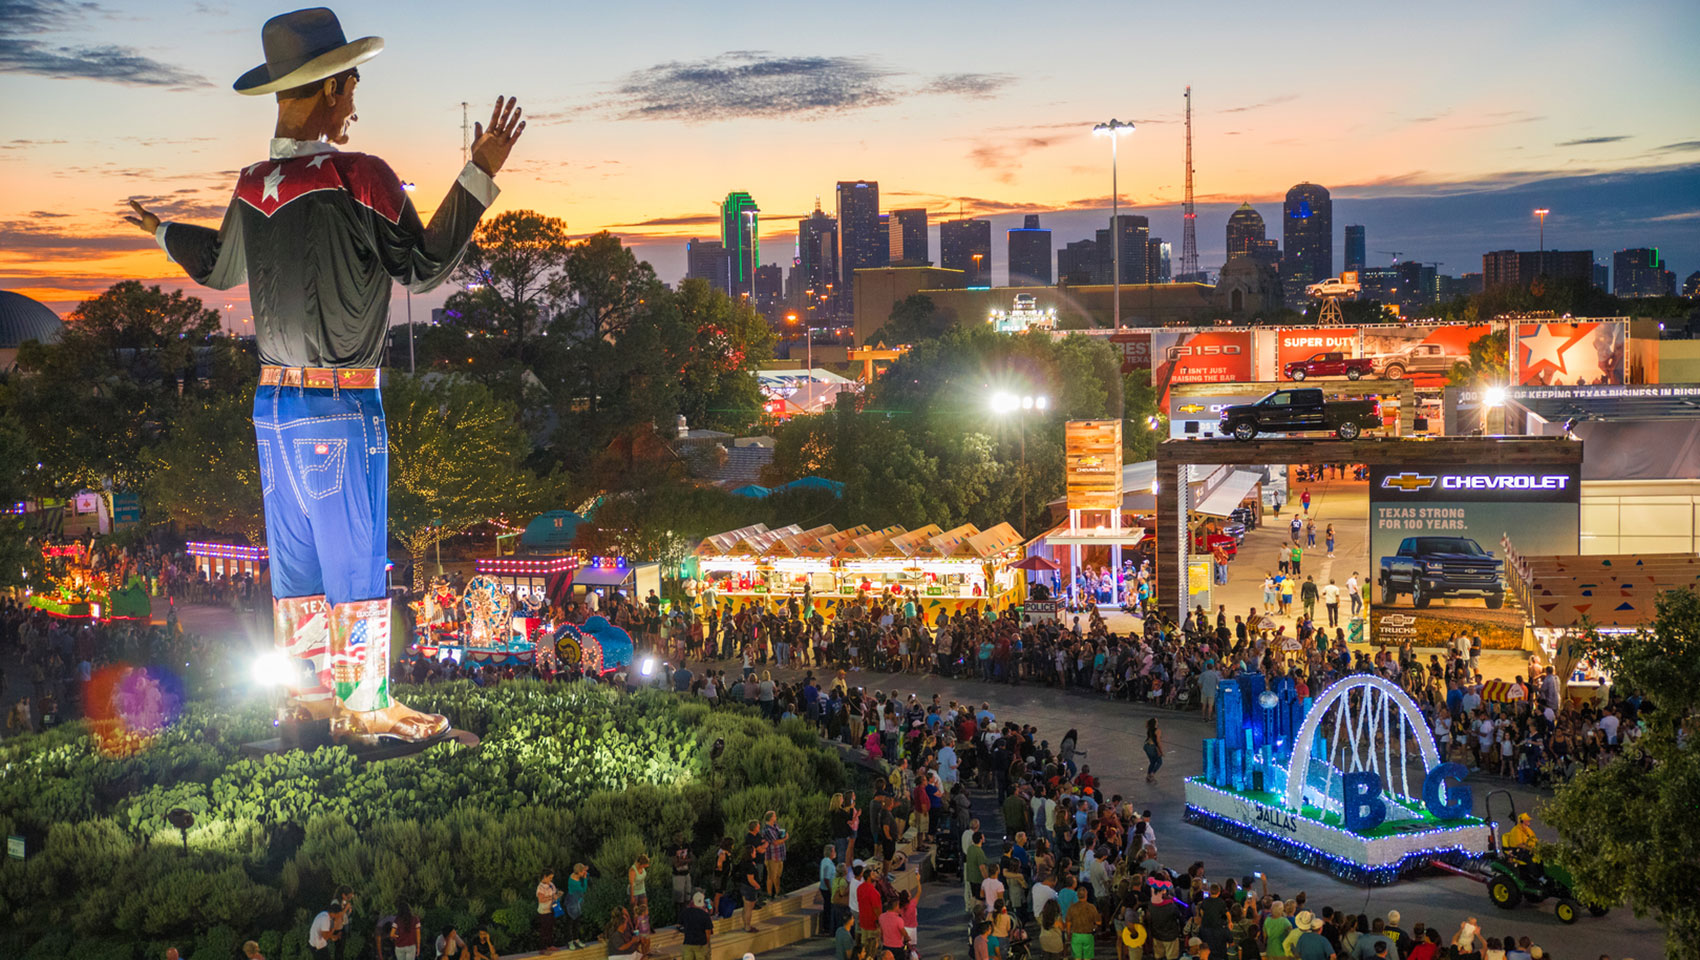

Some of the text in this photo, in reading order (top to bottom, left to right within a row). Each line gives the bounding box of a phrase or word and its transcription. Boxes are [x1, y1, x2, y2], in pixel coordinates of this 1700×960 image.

[1284, 337, 1355, 347] SUPER DUTY
[263, 368, 281, 383] BIG
[1460, 392, 1477, 400] 100
[1514, 391, 1527, 399] OF
[1529, 390, 1571, 399] KEEPING
[1573, 390, 1606, 398] TEXAS
[1607, 388, 1659, 397] BUSINESS
[1661, 388, 1671, 396] IN
[1441, 475, 1570, 489] CHEVROLET
[1379, 508, 1465, 518] TEXAS STRONG
[1379, 519, 1468, 529] FOR 100 YEARS.
[1026, 603, 1055, 611] POLICE
